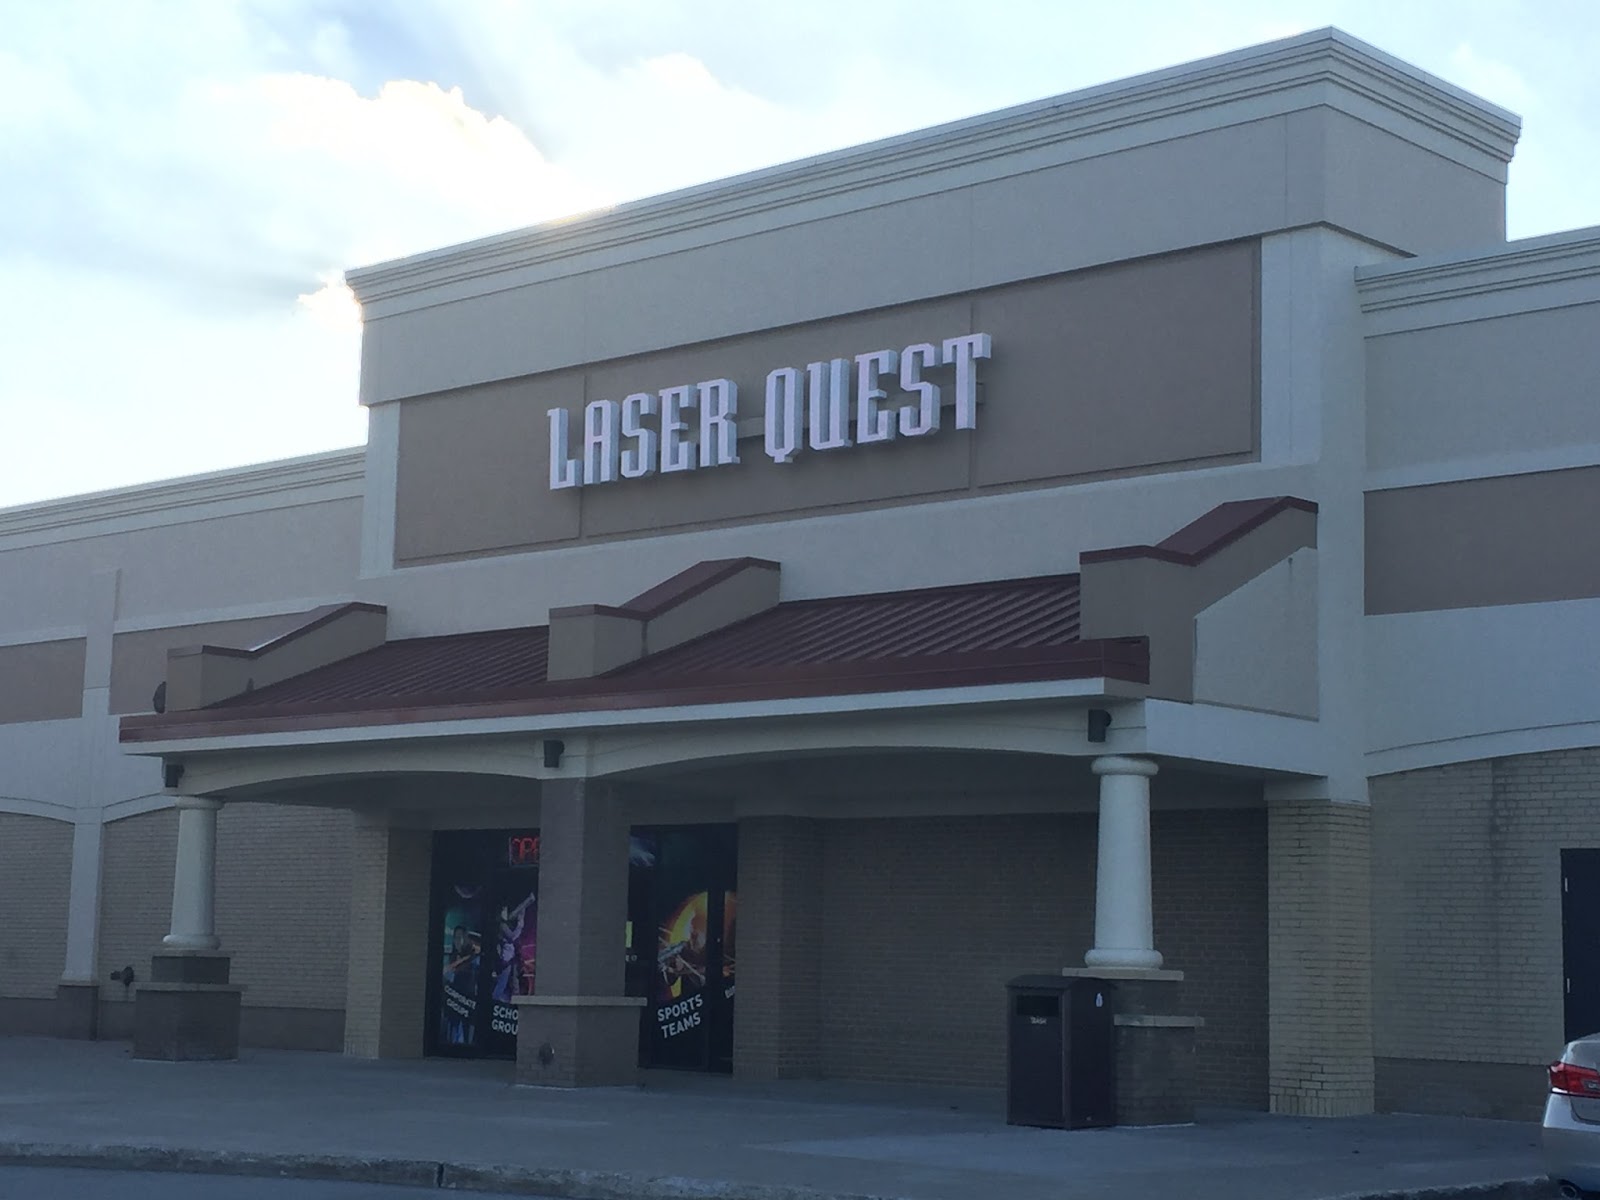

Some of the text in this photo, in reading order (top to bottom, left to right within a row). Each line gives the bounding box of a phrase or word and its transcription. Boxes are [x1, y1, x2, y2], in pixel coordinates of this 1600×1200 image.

[547, 332, 992, 490] LASER QUEST
[657, 993, 703, 1022] SPORTS
[661, 1012, 701, 1039] TEAMS
